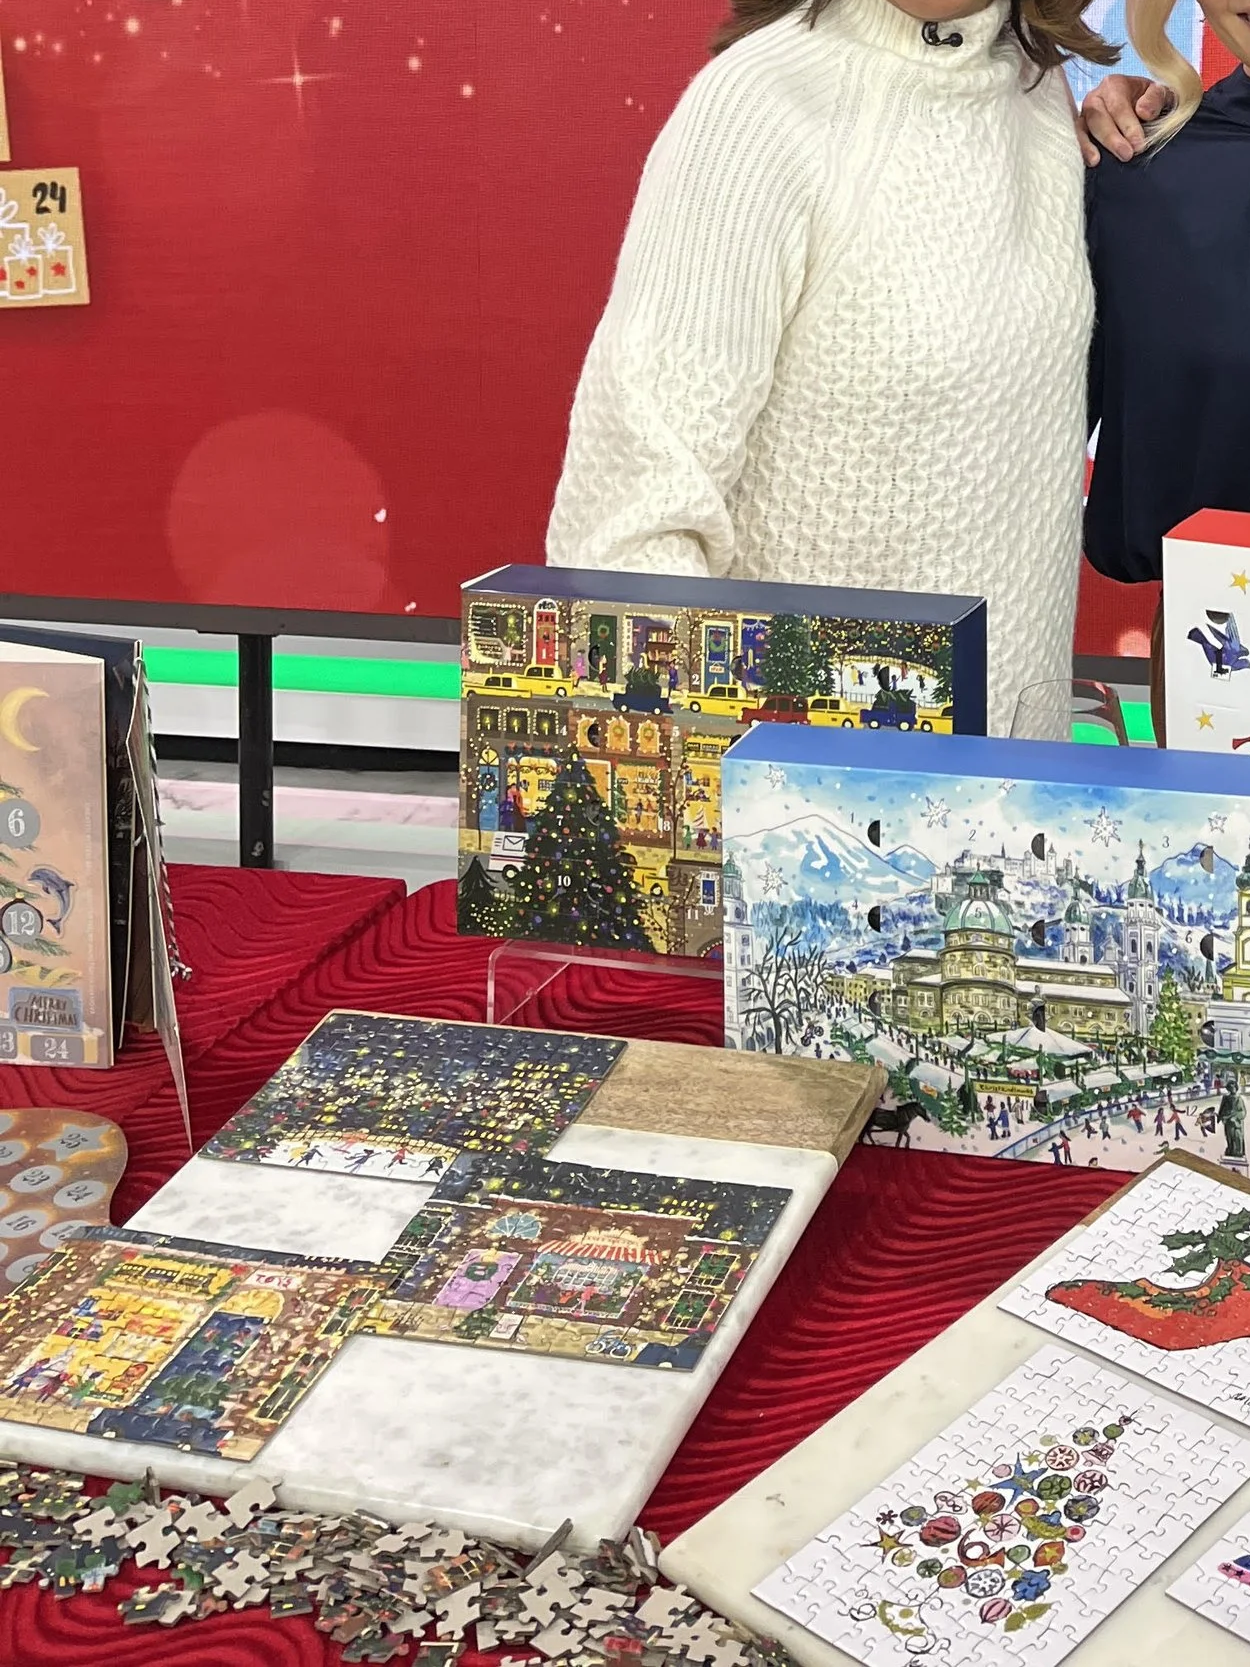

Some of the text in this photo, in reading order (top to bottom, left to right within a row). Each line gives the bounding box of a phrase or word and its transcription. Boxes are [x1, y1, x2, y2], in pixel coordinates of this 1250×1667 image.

[31, 181, 67, 215] 24
[691, 674, 699, 685] 2
[8, 808, 25, 837] 6
[556, 815, 563, 827] 7
[557, 875, 571, 887] 10
[8, 910, 35, 935] 12
[28, 995, 67, 1011] MERRY
[14, 1007, 78, 1027] CHRISTMAS
[44, 1037, 68, 1059] 24
[22, 1169, 50, 1186] 23
